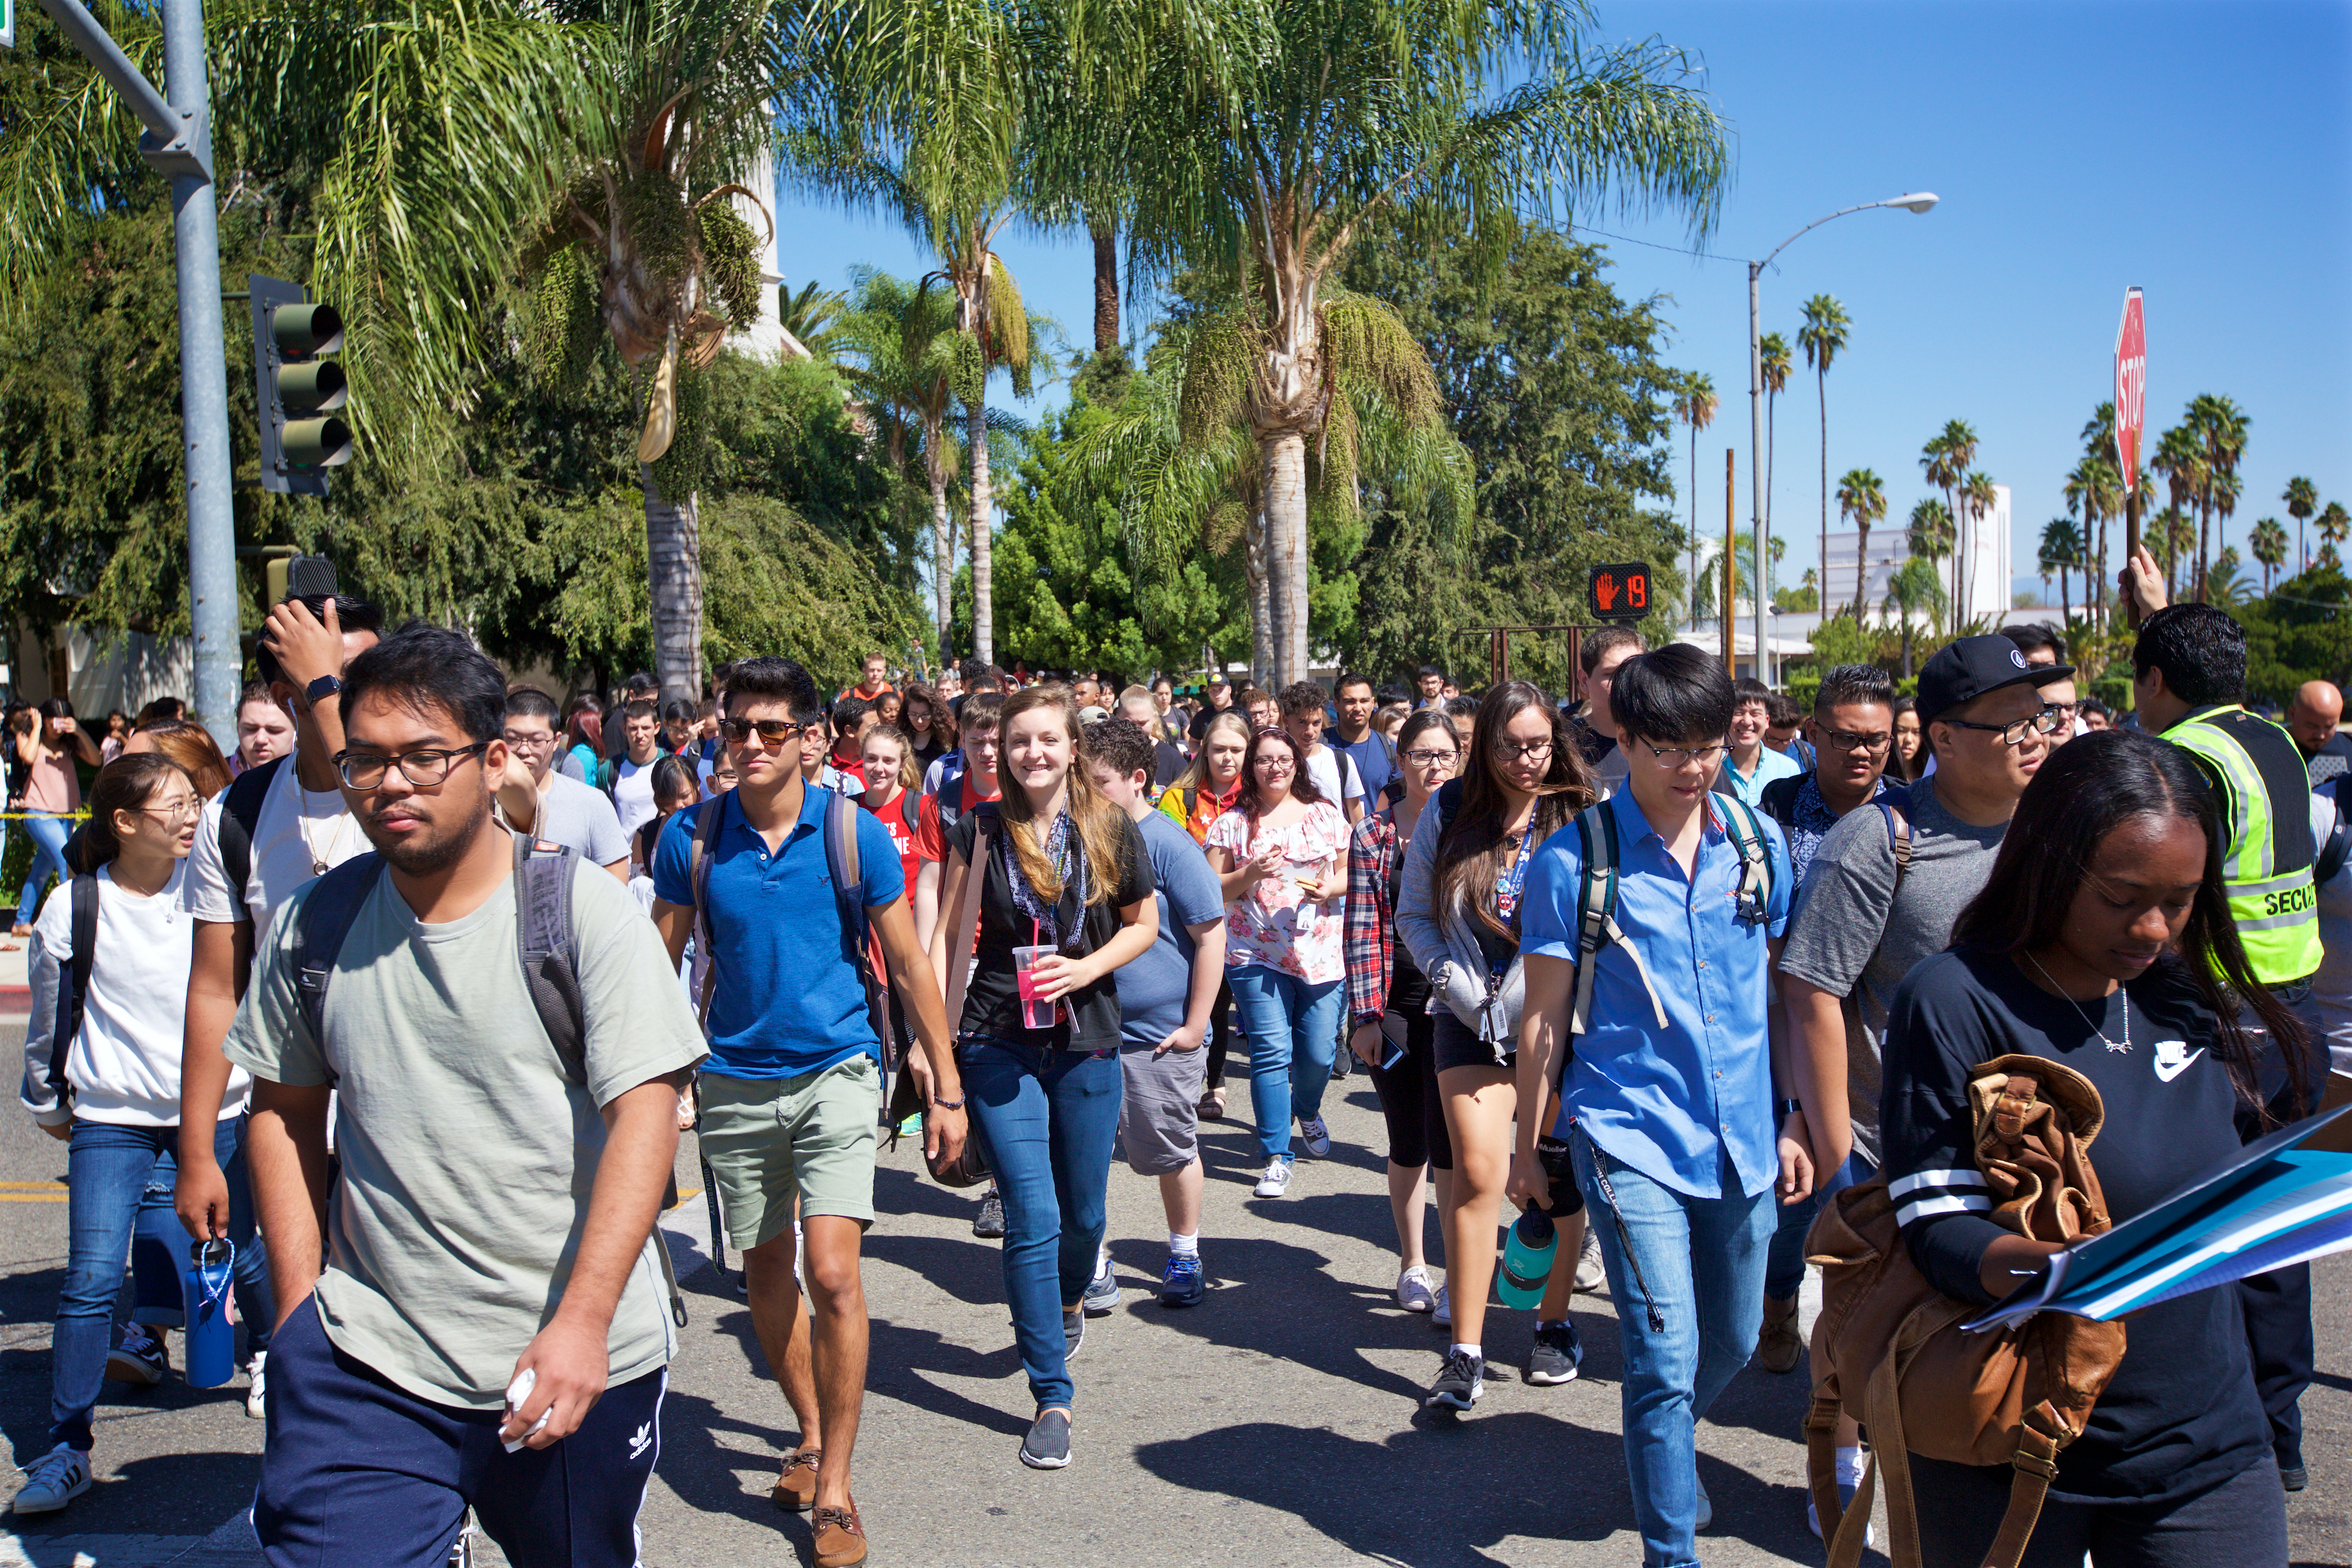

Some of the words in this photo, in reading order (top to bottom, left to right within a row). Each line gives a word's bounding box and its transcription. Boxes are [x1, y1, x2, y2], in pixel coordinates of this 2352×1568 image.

[2119, 355, 2144, 432] STOP
[1627, 575, 1645, 607] 19
[884, 822, 897, 837] TS
[893, 837, 910, 855] NE
[2264, 884, 2313, 915] SECU
[2154, 1040, 2187, 1064] NIKE
[1539, 1143, 1568, 1152] Mueller
[703, 1168, 715, 1215] UNIVERSITY
[1510, 1271, 1525, 1282] Flask
[630, 1437, 652, 1460] adidas
